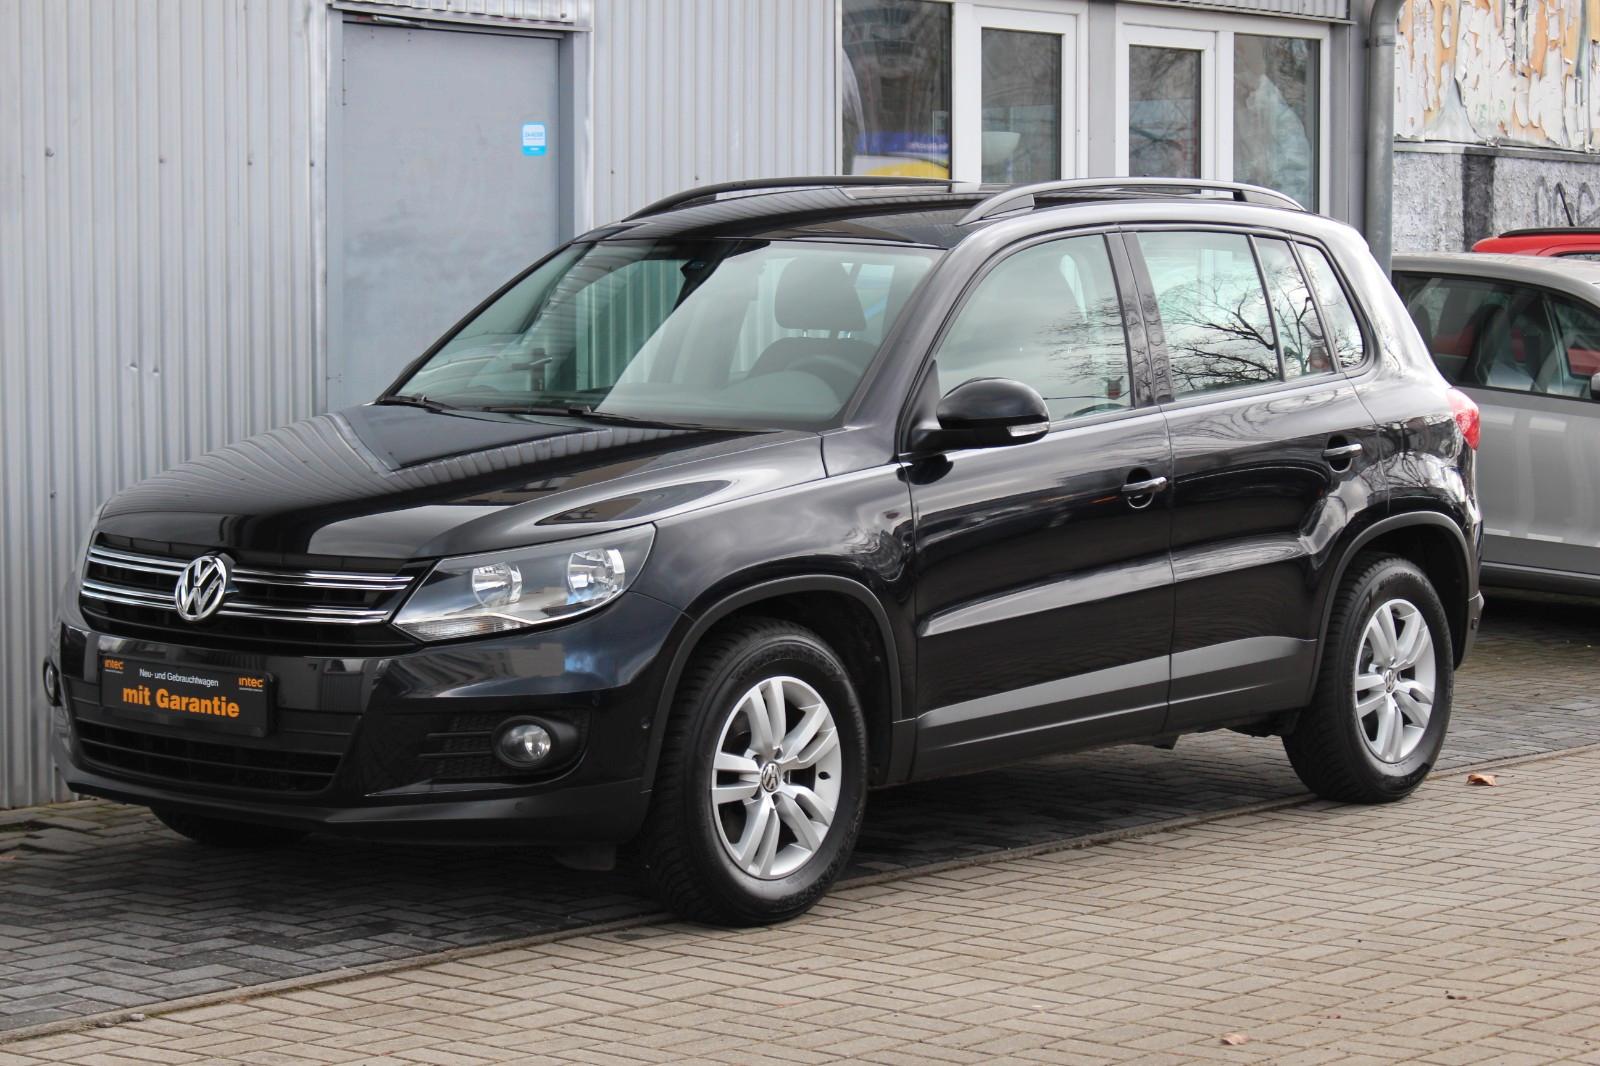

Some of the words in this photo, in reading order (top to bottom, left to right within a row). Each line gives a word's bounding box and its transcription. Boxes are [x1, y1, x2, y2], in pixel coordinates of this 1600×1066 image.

[139, 668, 154, 679] Neu-
[154, 671, 166, 680] und
[167, 672, 219, 688] Gebrauchtwagen
[122, 685, 151, 706] mit
[155, 688, 240, 718] Garantie
